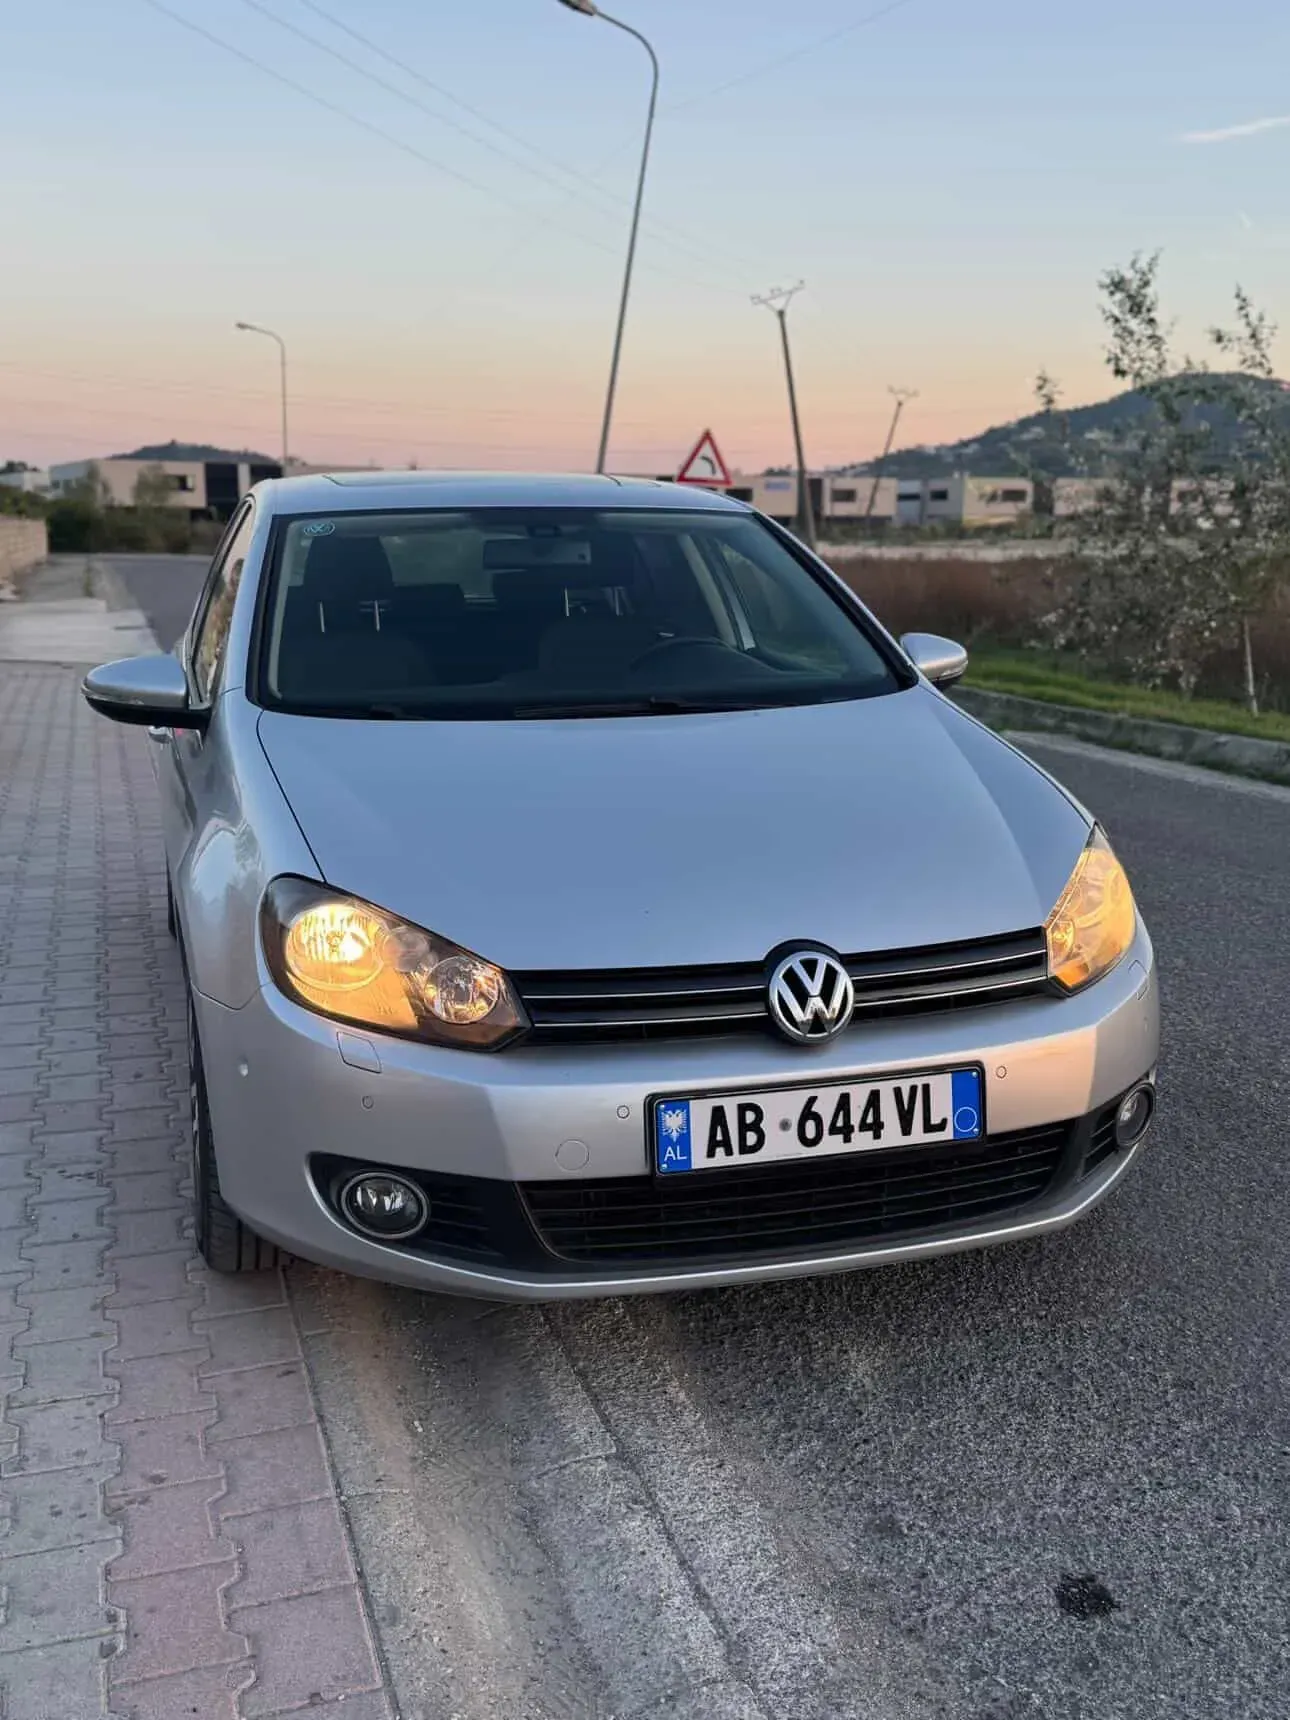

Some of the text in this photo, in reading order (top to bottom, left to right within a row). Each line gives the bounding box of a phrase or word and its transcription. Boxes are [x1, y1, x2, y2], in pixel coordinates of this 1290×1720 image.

[774, 955, 850, 1035] VW
[664, 1145, 687, 1161] AL
[706, 1083, 948, 1159] AB 644 VL
